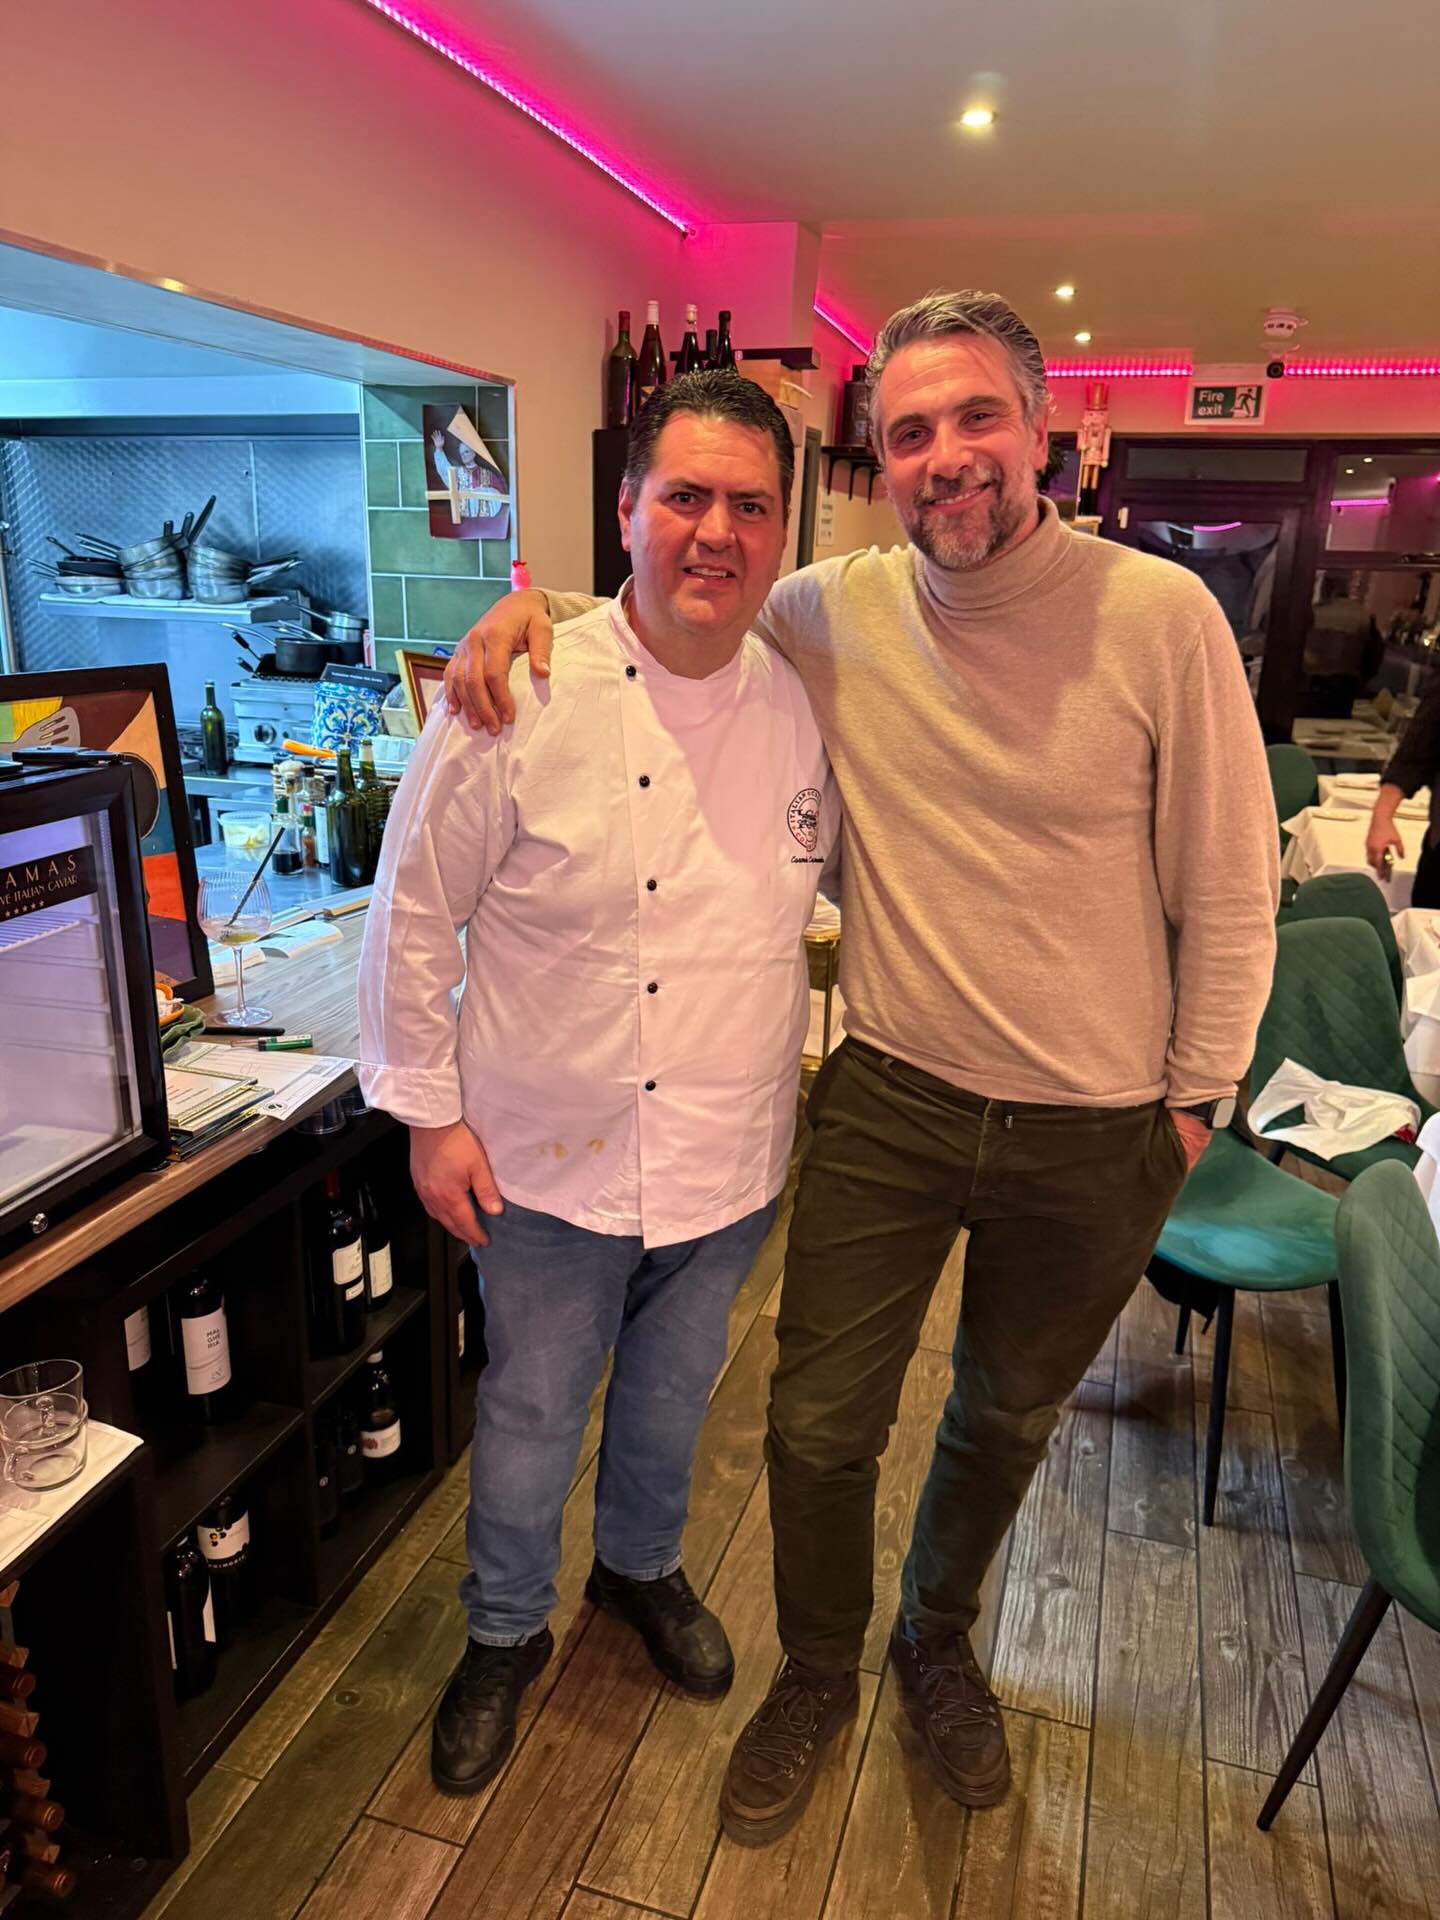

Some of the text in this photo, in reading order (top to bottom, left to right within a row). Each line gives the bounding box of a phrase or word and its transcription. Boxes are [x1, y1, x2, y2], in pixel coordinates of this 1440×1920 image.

[1199, 390, 1225, 402] Fire
[1198, 403, 1223, 416] exit
[6, 854, 77, 889] AMAS
[14, 884, 45, 902] ITALIAN
[47, 875, 79, 892] CAVIAR
